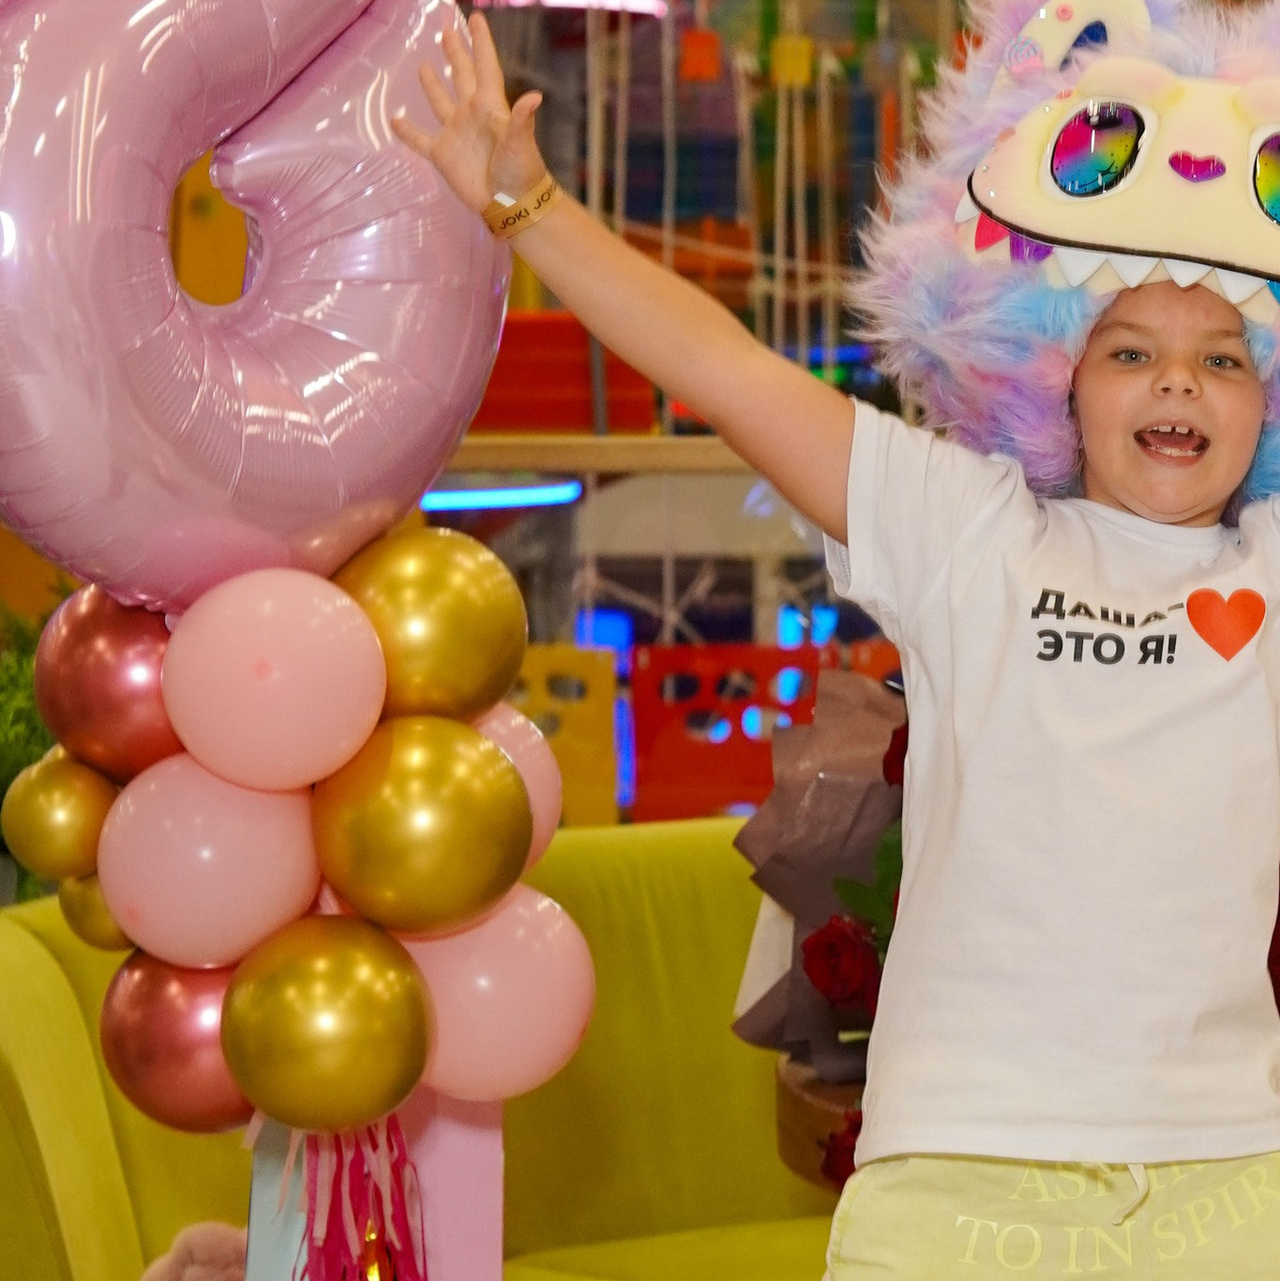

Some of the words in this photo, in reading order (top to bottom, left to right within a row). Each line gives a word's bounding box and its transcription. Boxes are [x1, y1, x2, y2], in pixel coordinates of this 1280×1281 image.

[500, 208, 530, 230] JOKI
[1036, 629, 1126, 665] ЭТО
[1137, 633, 1178, 665] Я!
[954, 1214, 1043, 1272] TO
